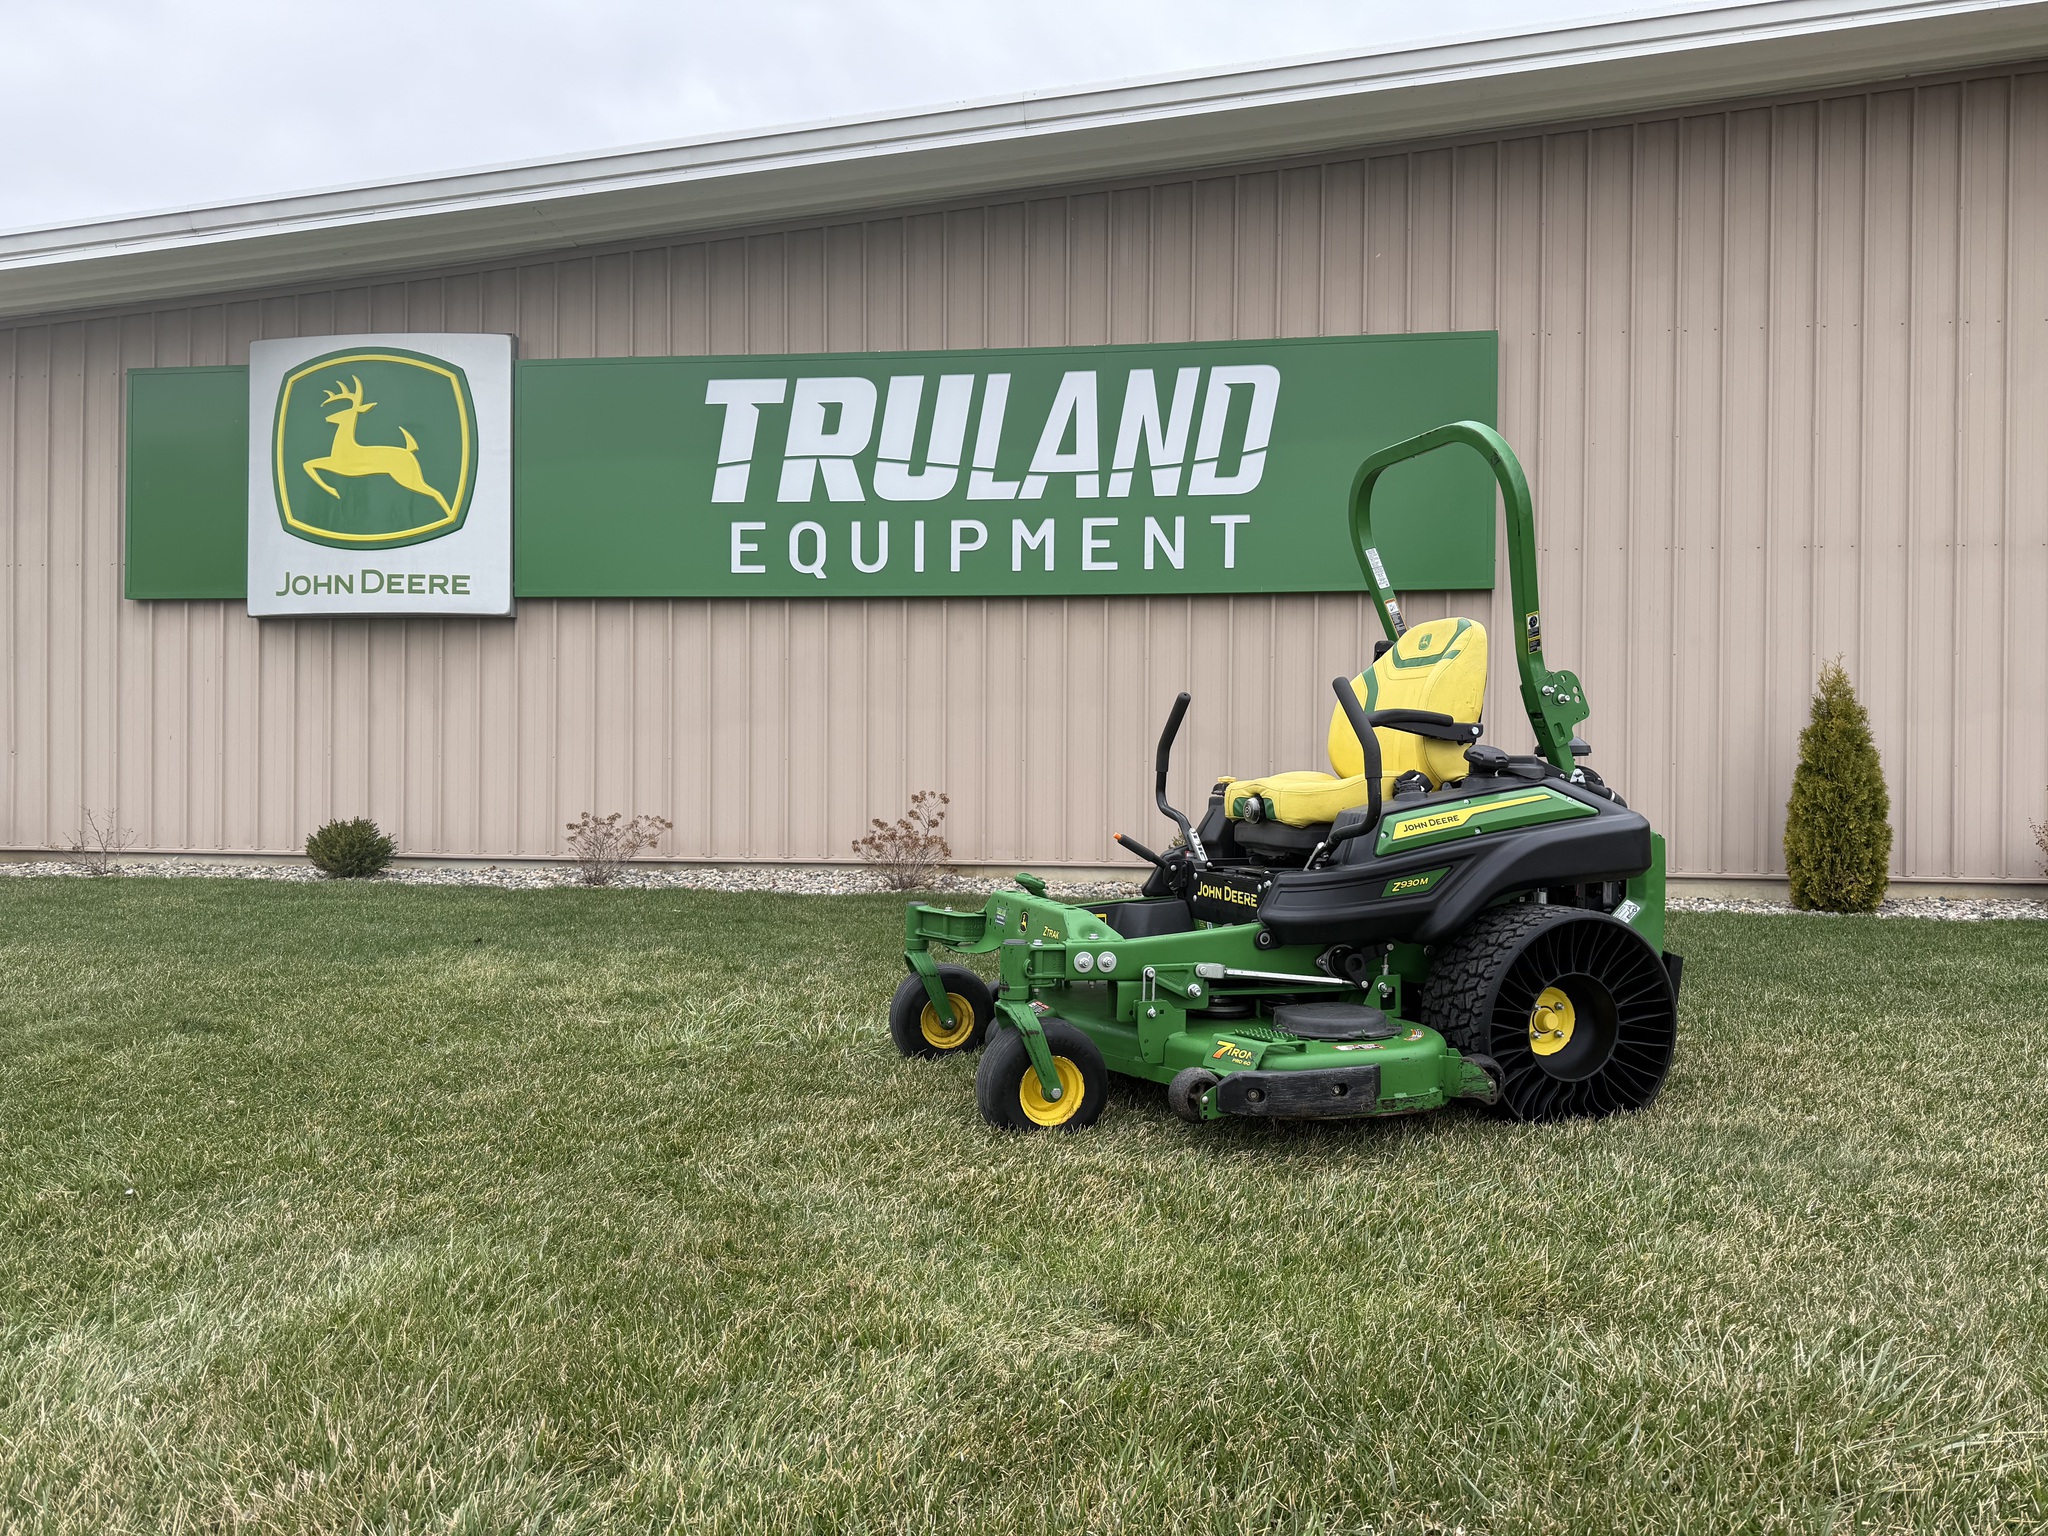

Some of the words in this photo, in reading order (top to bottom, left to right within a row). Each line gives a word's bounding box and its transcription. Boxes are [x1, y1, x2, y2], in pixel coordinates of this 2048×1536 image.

[705, 364, 1281, 503] TRULAND
[731, 514, 1250, 579] EQUIPMENT
[276, 571, 354, 597] JOHN
[361, 569, 471, 595] DEERE
[1403, 821, 1428, 833] JOHN
[1428, 814, 1460, 828] DEERE
[1197, 881, 1222, 900] JOHN
[1224, 885, 1258, 908] DEERE
[1042, 926, 1060, 940] ZTRAK
